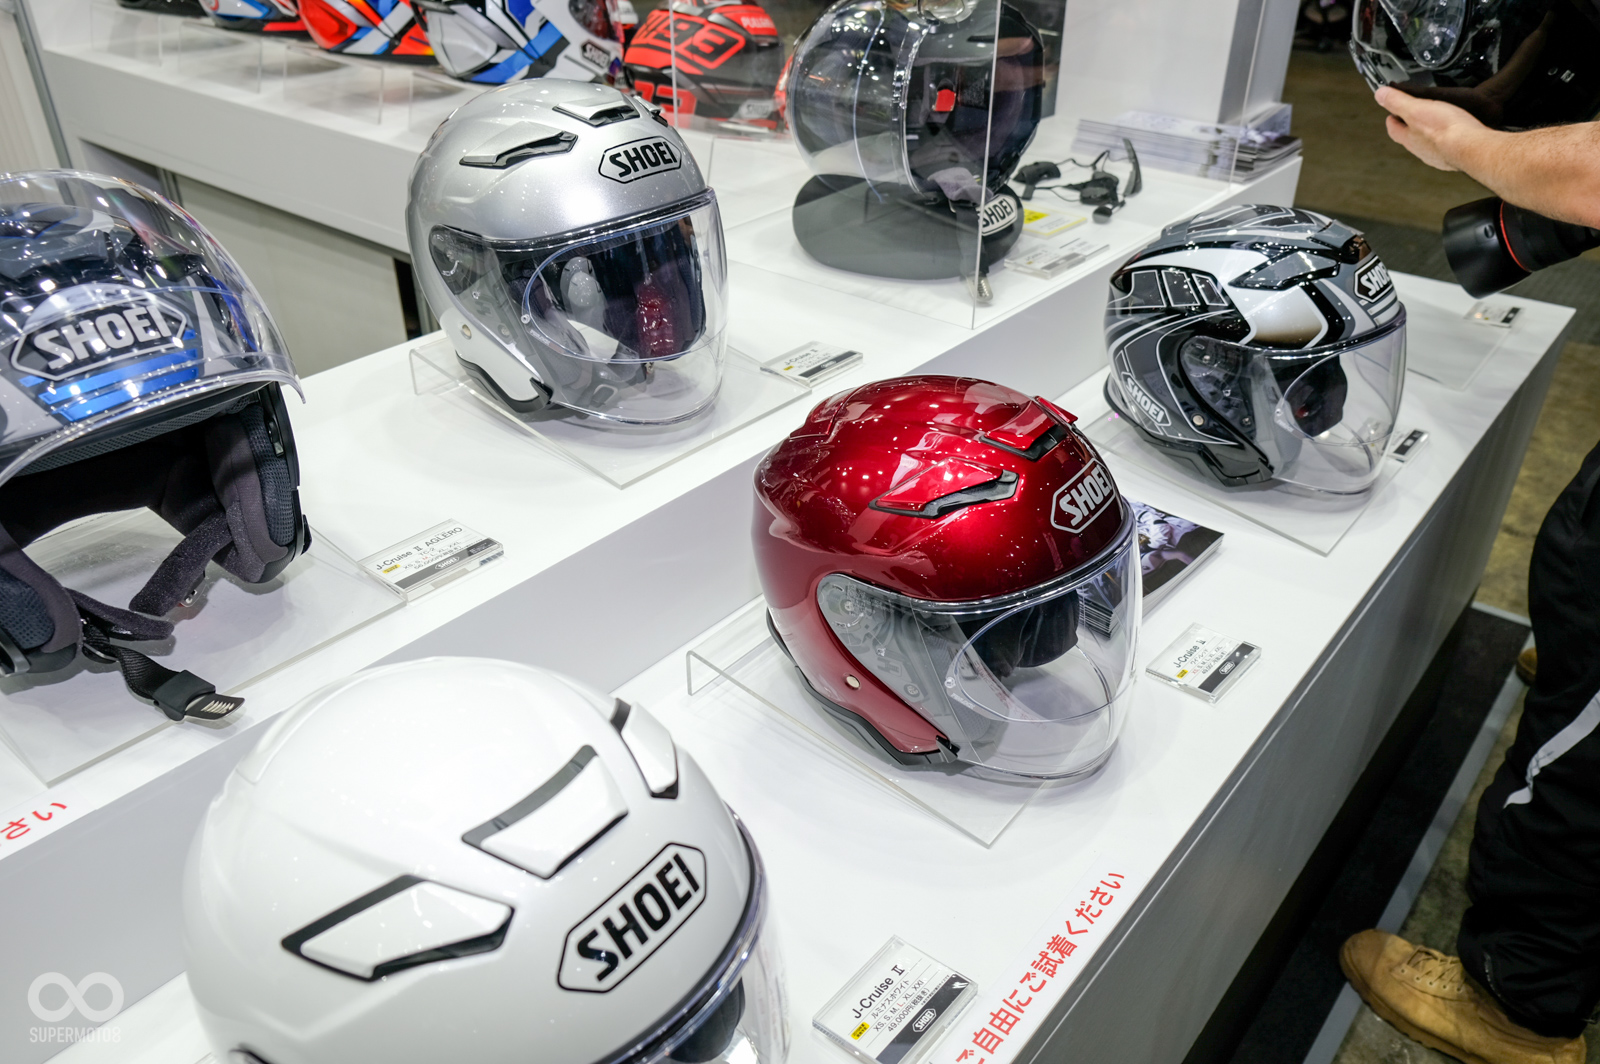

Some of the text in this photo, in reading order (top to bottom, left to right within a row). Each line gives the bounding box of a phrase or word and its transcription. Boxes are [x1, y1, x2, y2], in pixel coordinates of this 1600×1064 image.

[609, 141, 677, 177] SHOEI
[1360, 261, 1391, 297] SHOE
[34, 306, 172, 369] SHOEI
[1126, 377, 1165, 422] SHOEI
[1059, 465, 1113, 526] SHOEI
[376, 551, 413, 570] J-Cruise
[425, 527, 463, 547] AGLERO
[1174, 645, 1200, 668] J-Cruise
[577, 853, 699, 982] SHOEI
[956, 872, 1125, 1064] ご自由にご試着ください
[853, 978, 894, 1019] J-Cruise
[871, 980, 909, 1019] ルミナスホワイト
[915, 1011, 936, 1029] SHOEI
